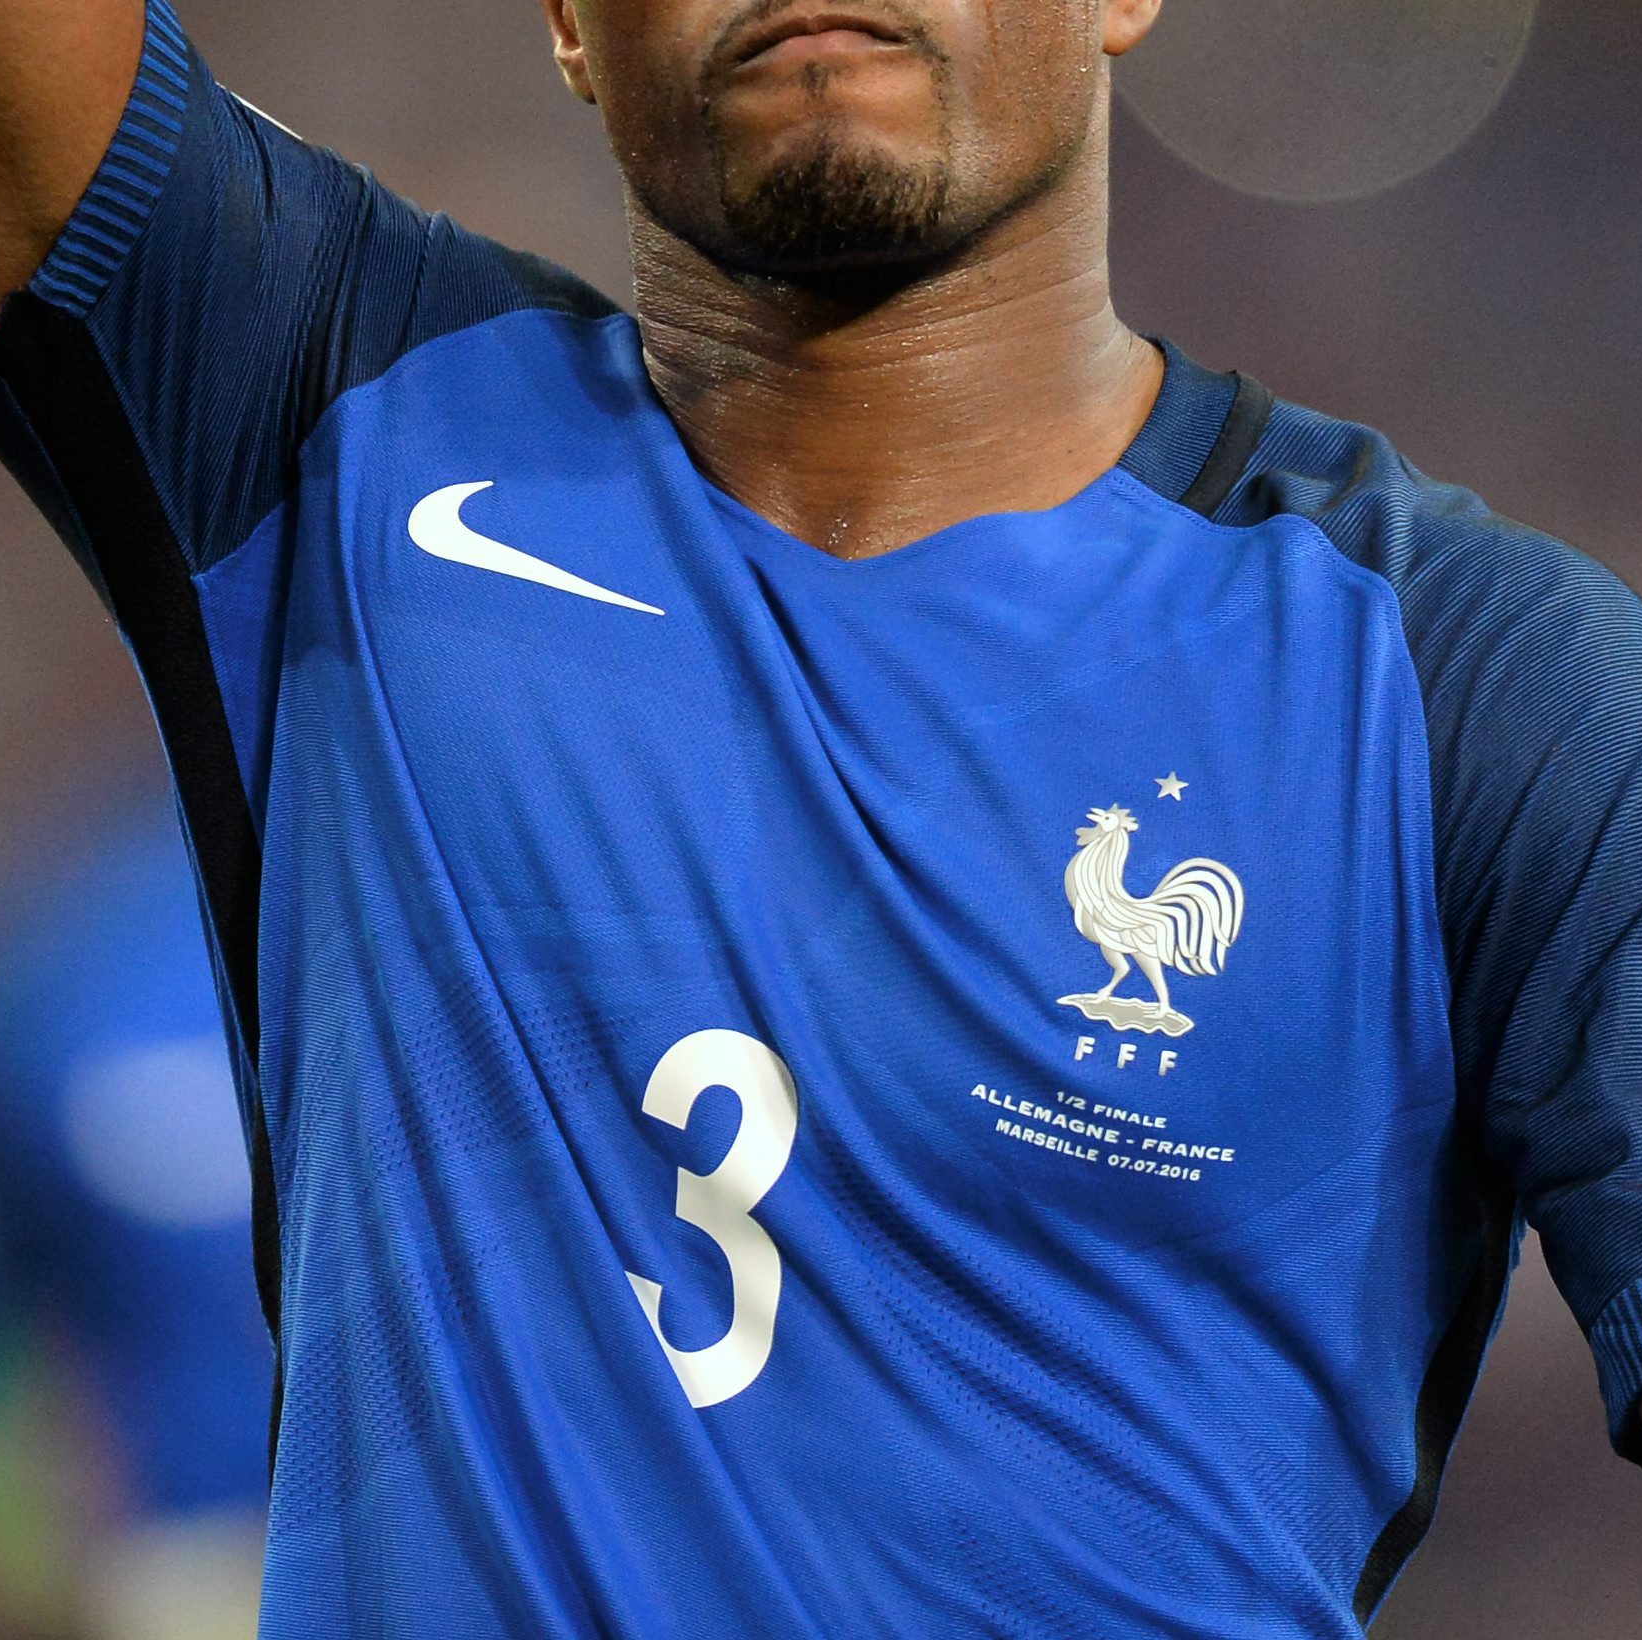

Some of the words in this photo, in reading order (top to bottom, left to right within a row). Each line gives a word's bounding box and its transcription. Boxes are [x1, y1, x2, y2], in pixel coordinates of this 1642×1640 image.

[970, 1083, 1120, 1144] ALLEMAGNE
[1142, 1138, 1236, 1162] FRANCE
[1056, 1091, 1086, 1110] 1/2
[1093, 1104, 1167, 1129] FINALE
[995, 1118, 1099, 1162] MARSEILLE
[1107, 1153, 1201, 1182] 07.07.2016
[625, 1028, 798, 1408] 3
